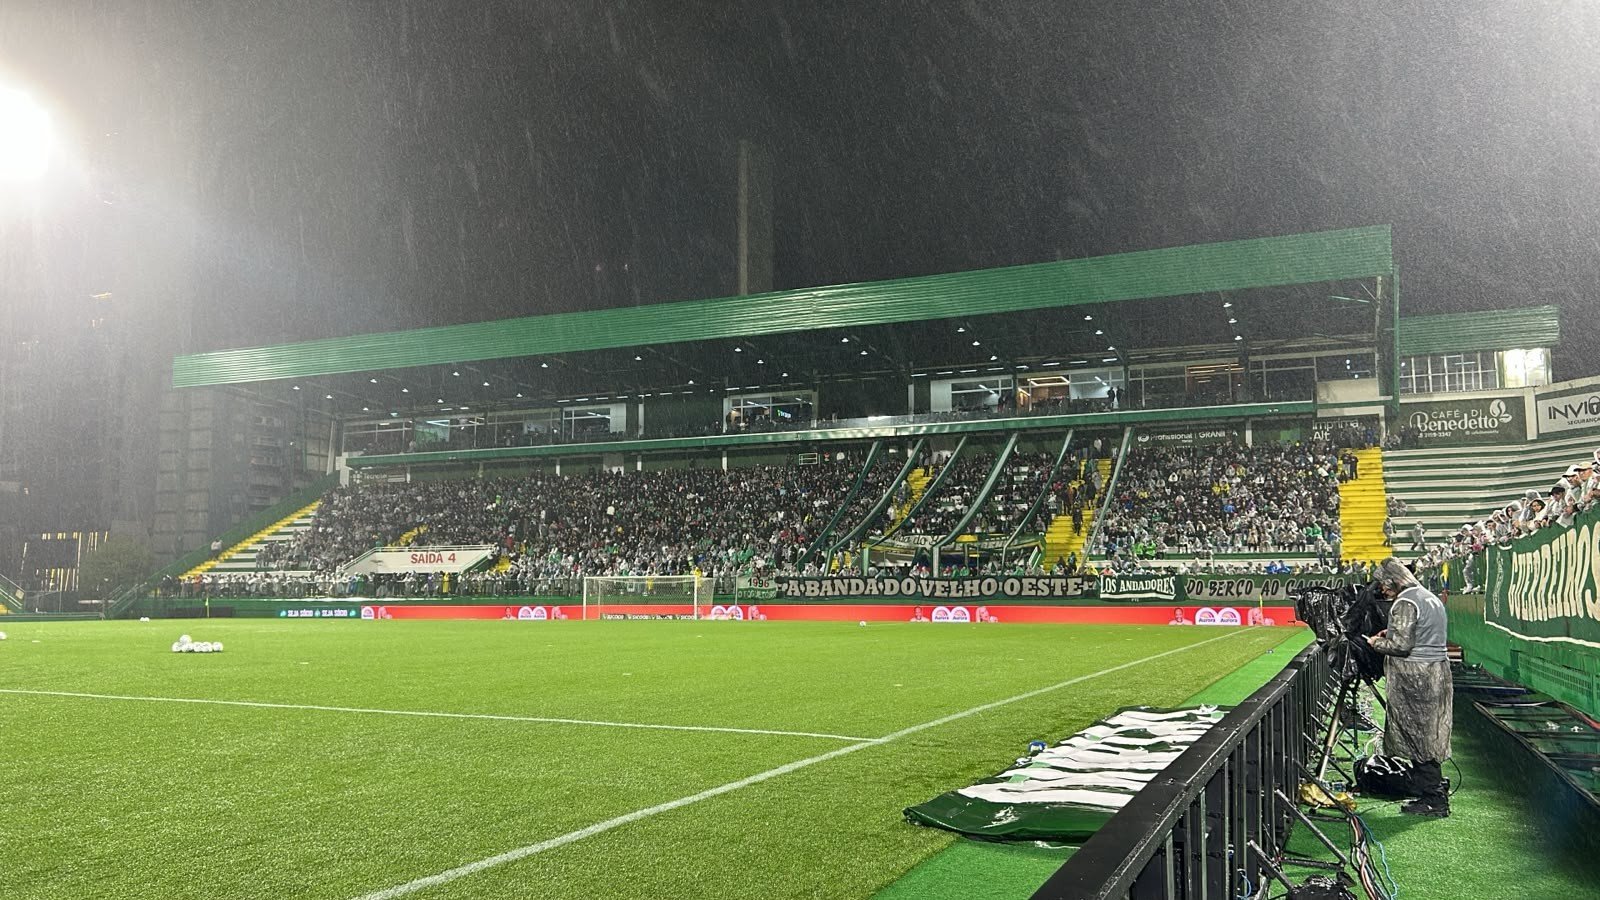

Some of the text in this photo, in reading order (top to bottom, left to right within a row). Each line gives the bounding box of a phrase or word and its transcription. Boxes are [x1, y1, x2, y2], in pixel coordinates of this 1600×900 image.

[1410, 411, 1498, 431] Benedetto
[1431, 409, 1483, 418] CAFÉ DI
[448, 553, 456, 564] 4
[748, 578, 770, 588] 1996
[786, 577, 1083, 598] A BANDA DO VELHO OESTE
[1100, 575, 1176, 595] LOS ANDADORES
[1186, 579, 1204, 595] DO
[1208, 579, 1254, 597] BERÇO
[1260, 579, 1279, 596] AO
